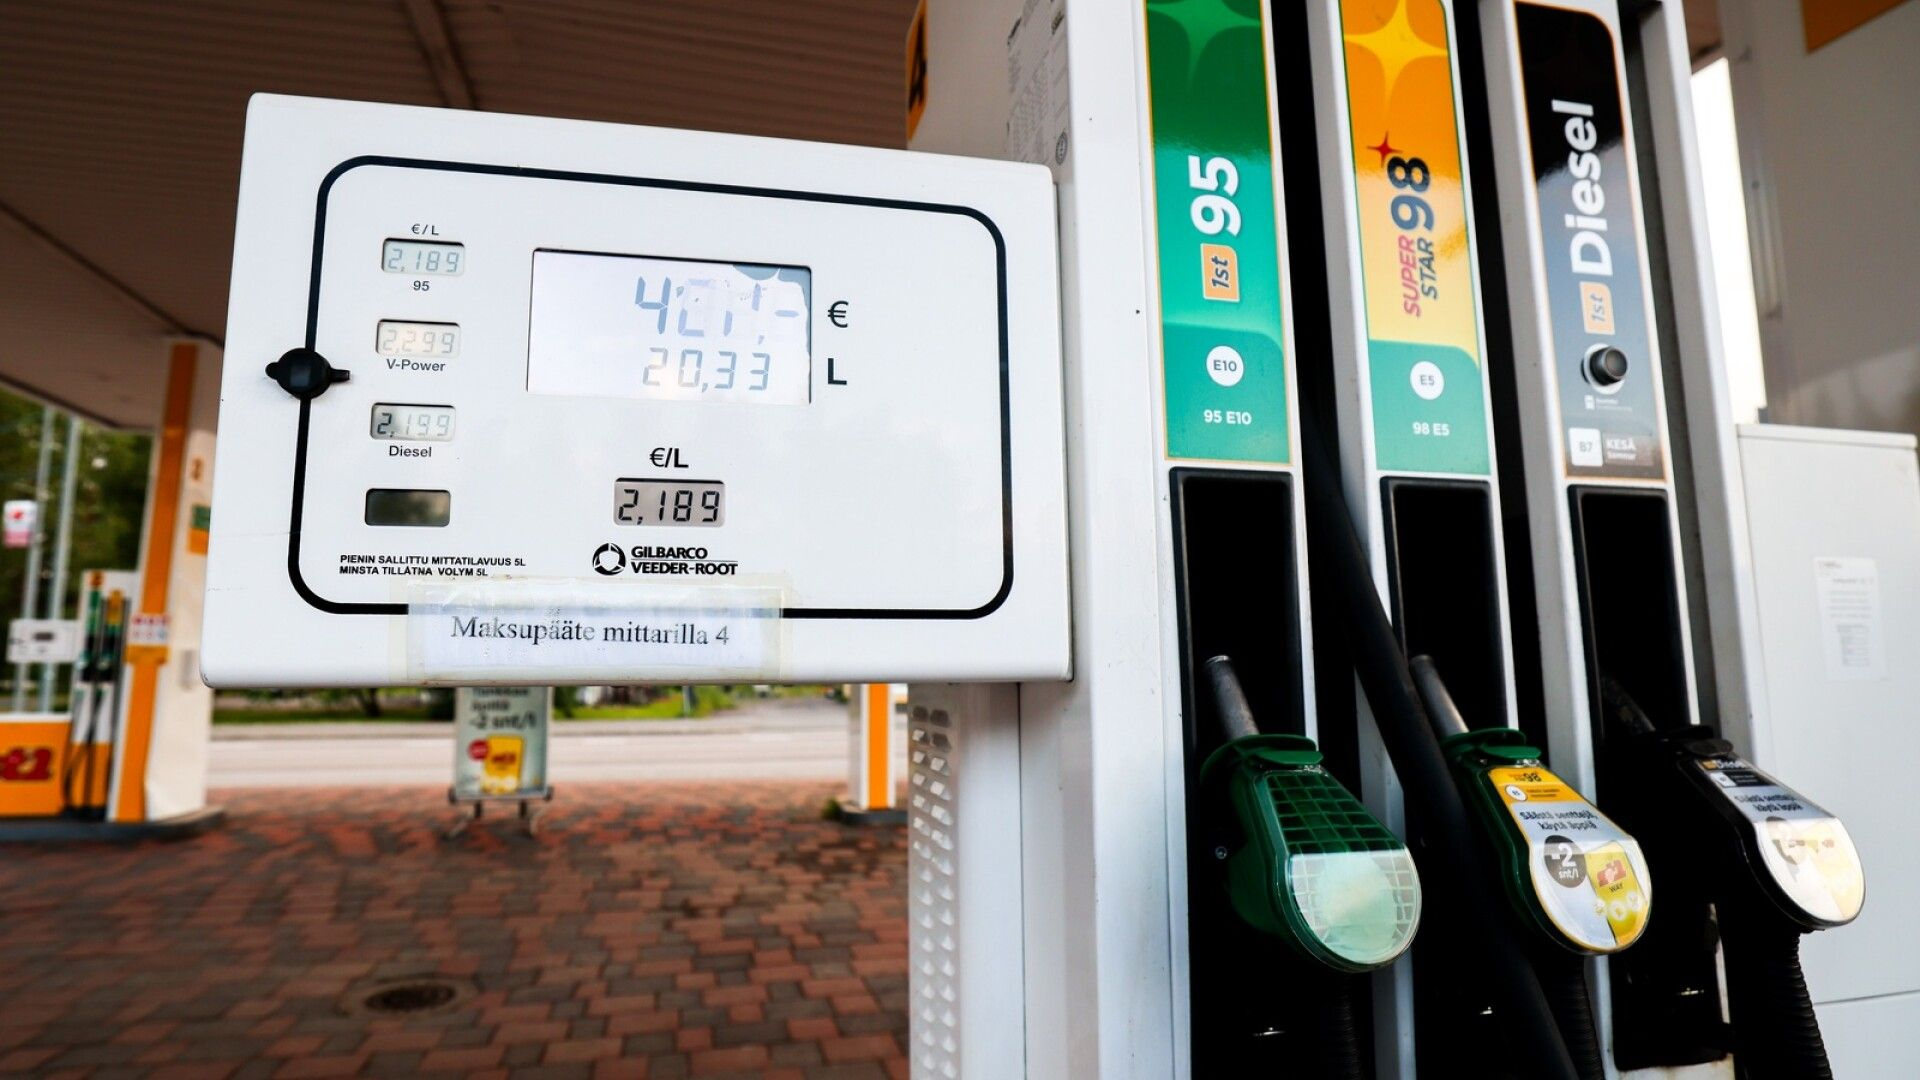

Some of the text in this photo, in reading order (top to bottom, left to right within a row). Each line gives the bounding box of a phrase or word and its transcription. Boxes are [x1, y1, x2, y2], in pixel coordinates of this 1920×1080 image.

[1188, 155, 1242, 236] 95
[1387, 156, 1434, 231] 98
[1551, 99, 1613, 276] Diesel
[411, 223, 440, 236] €/L
[387, 248, 460, 273] 2,189
[1417, 236, 1438, 301] STAR
[1211, 255, 1230, 288] 1st
[1398, 234, 1421, 318] SUPER
[413, 280, 430, 291] 95
[386, 358, 446, 372] V-Power
[642, 347, 770, 393] 20,33
[827, 358, 847, 385] L
[1213, 359, 1237, 372] E10
[1420, 375, 1435, 385] E5
[1203, 409, 1252, 425] 95 E10
[1412, 421, 1450, 436] 98 E5
[389, 445, 432, 457] Diesel
[649, 447, 689, 468] €/L
[618, 489, 720, 525] 2,189
[340, 554, 526, 567] PIENIN SALLITTU MITTATILAVUUS 5L
[631, 546, 708, 559] GILBARCO
[339, 566, 380, 575] MINSTA
[438, 568, 473, 576] VOLYM
[476, 568, 488, 577] 5L
[631, 561, 738, 575] VEEDER-ROOT
[451, 616, 729, 645] Maksupääte mittarilla 4
[1552, 842, 1576, 868] -2
